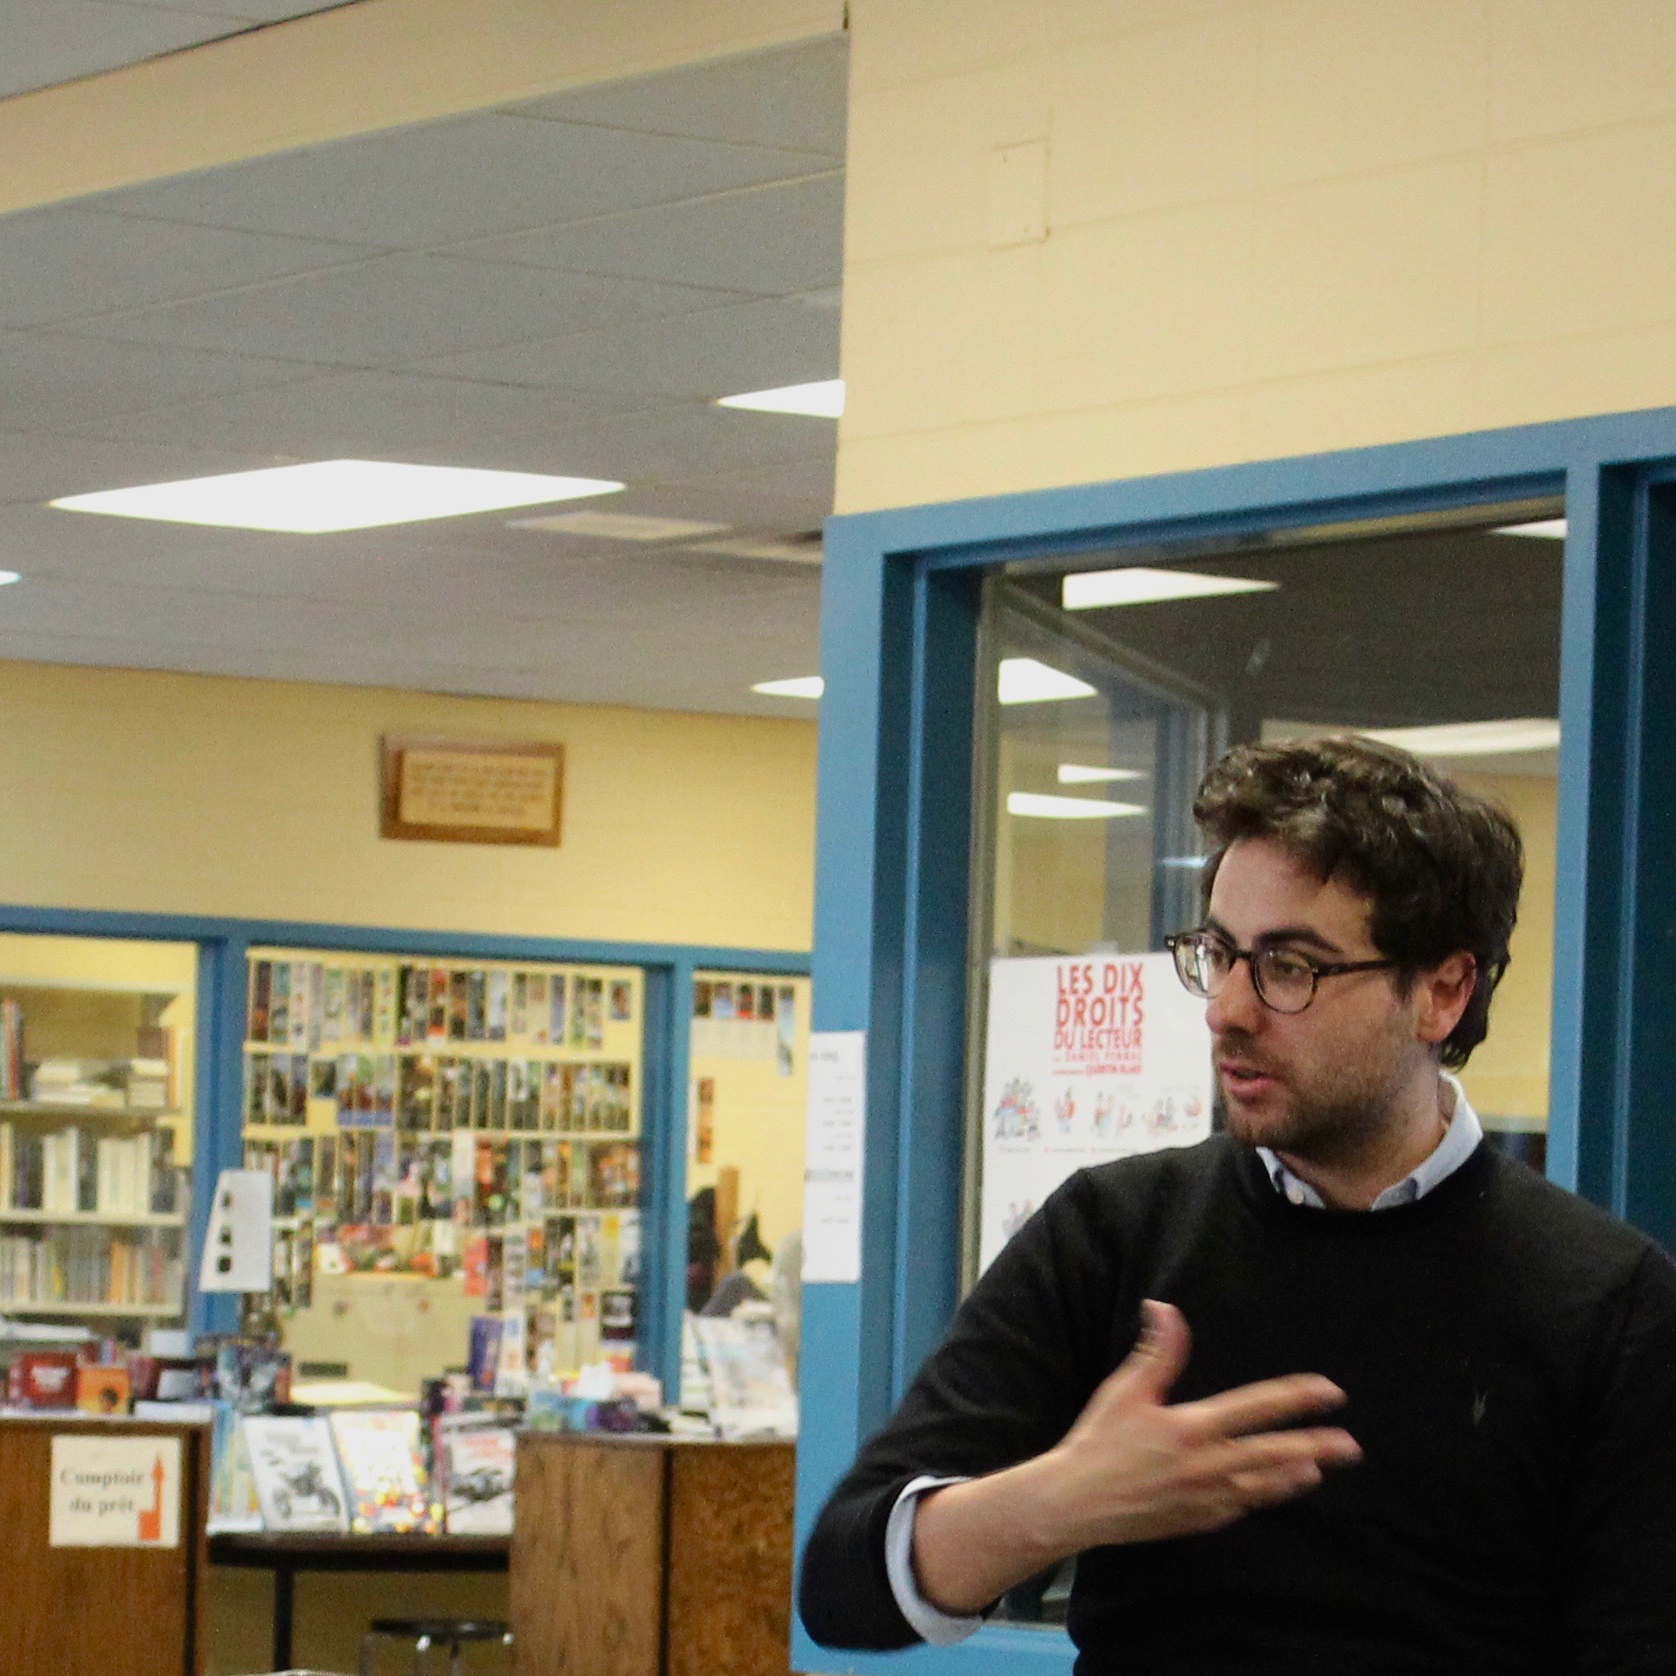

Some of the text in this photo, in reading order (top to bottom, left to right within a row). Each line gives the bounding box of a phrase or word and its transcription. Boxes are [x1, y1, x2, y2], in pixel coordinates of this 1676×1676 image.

[1057, 963, 1143, 994] LES DIX
[1056, 996, 1143, 1027] DROITS
[1054, 1027, 1142, 1049] DU LECTEUR
[60, 1467, 144, 1490] Comptoir
[70, 1497, 92, 1512] du
